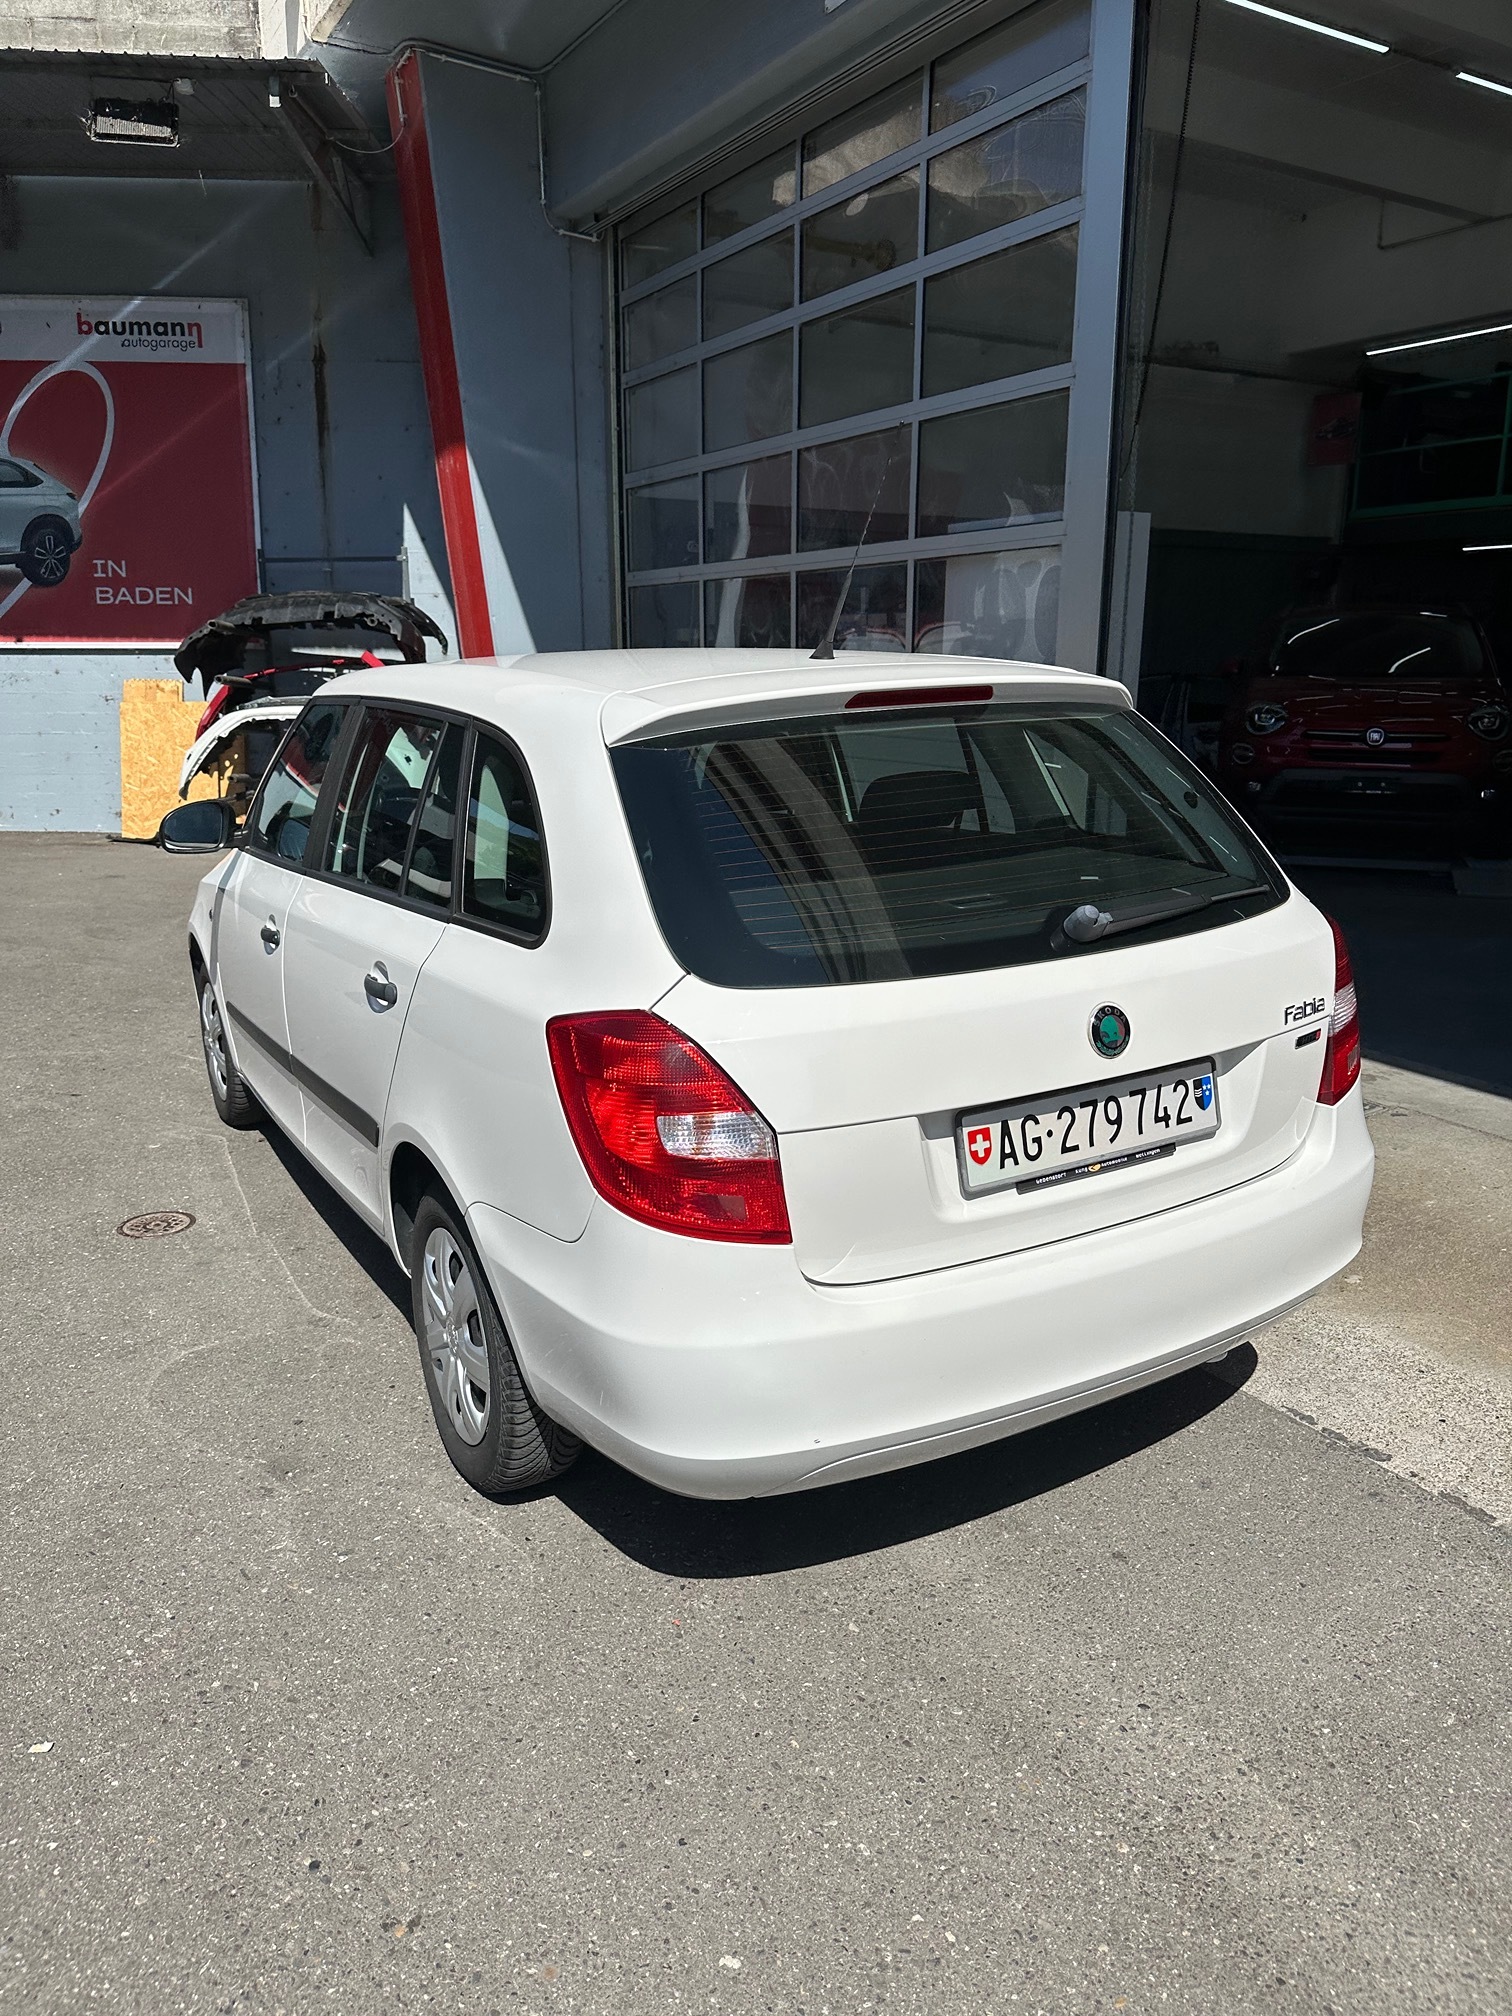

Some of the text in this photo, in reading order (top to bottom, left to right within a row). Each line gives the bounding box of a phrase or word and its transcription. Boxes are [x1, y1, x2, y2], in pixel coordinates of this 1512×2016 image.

[76, 312, 203, 348] baumann
[121, 337, 196, 352] autogarage
[92, 559, 127, 577] IN
[95, 587, 193, 604] BADEN
[1284, 997, 1325, 1025] Fabia
